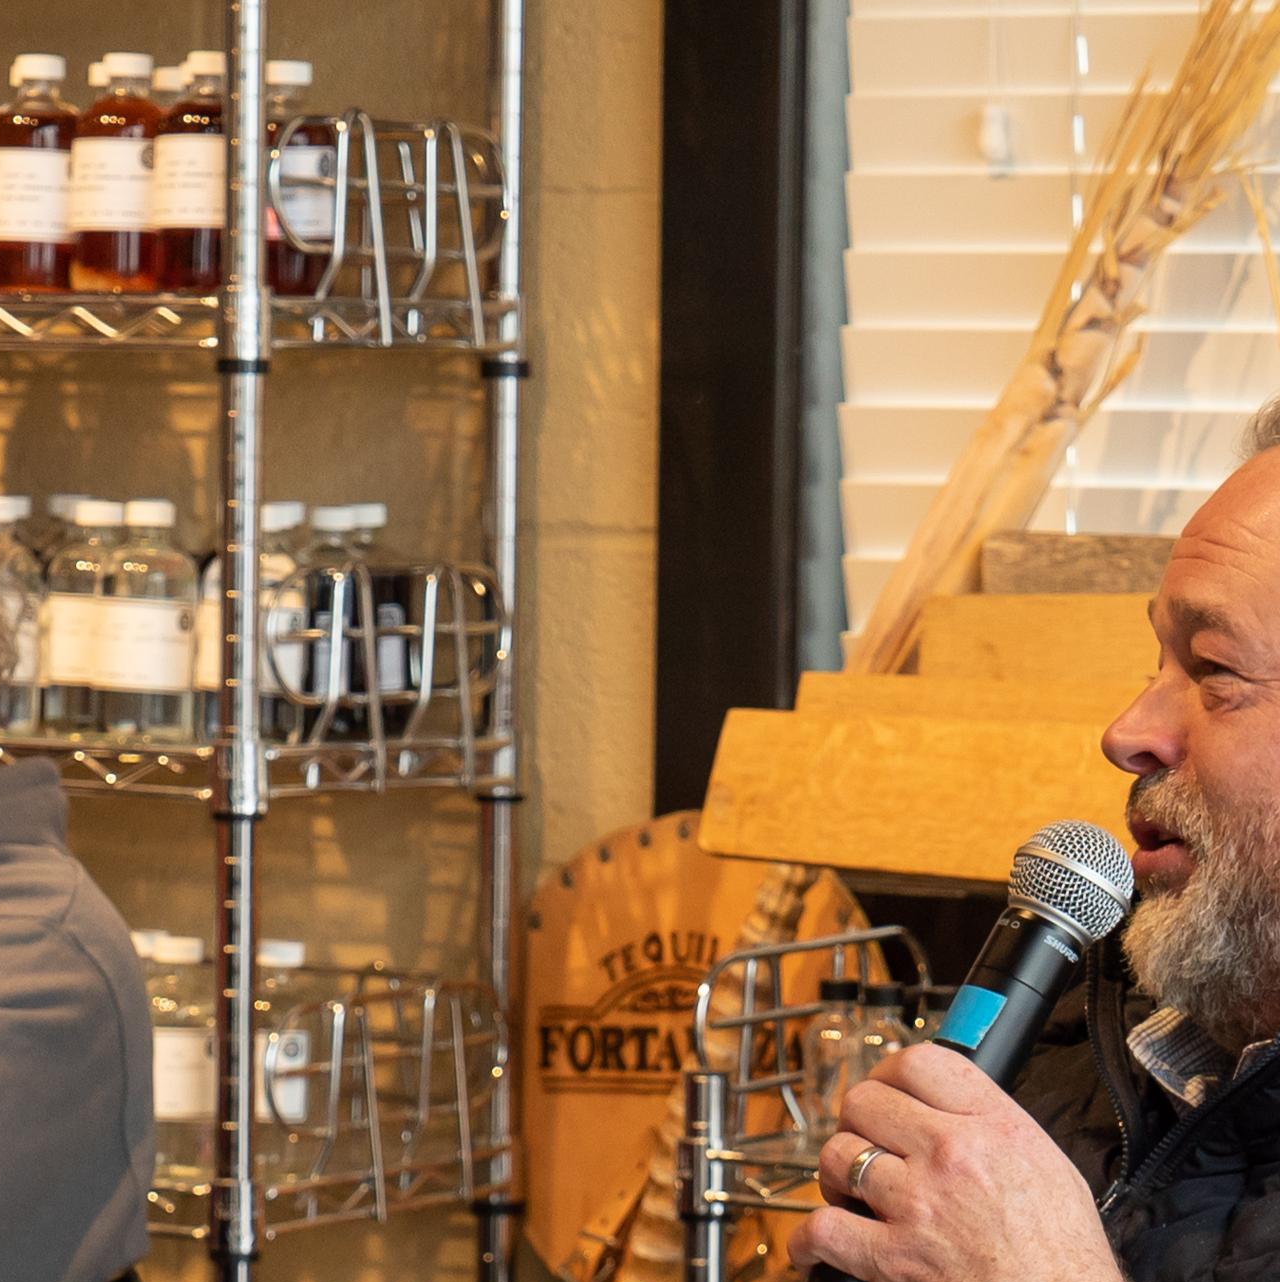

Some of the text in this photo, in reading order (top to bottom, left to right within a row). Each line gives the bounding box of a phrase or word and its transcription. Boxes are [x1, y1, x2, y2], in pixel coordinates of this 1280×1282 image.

[599, 931, 720, 982] TEQUIL
[1043, 935, 1079, 963] SHURE
[539, 1021, 804, 1072] FORTAZA
